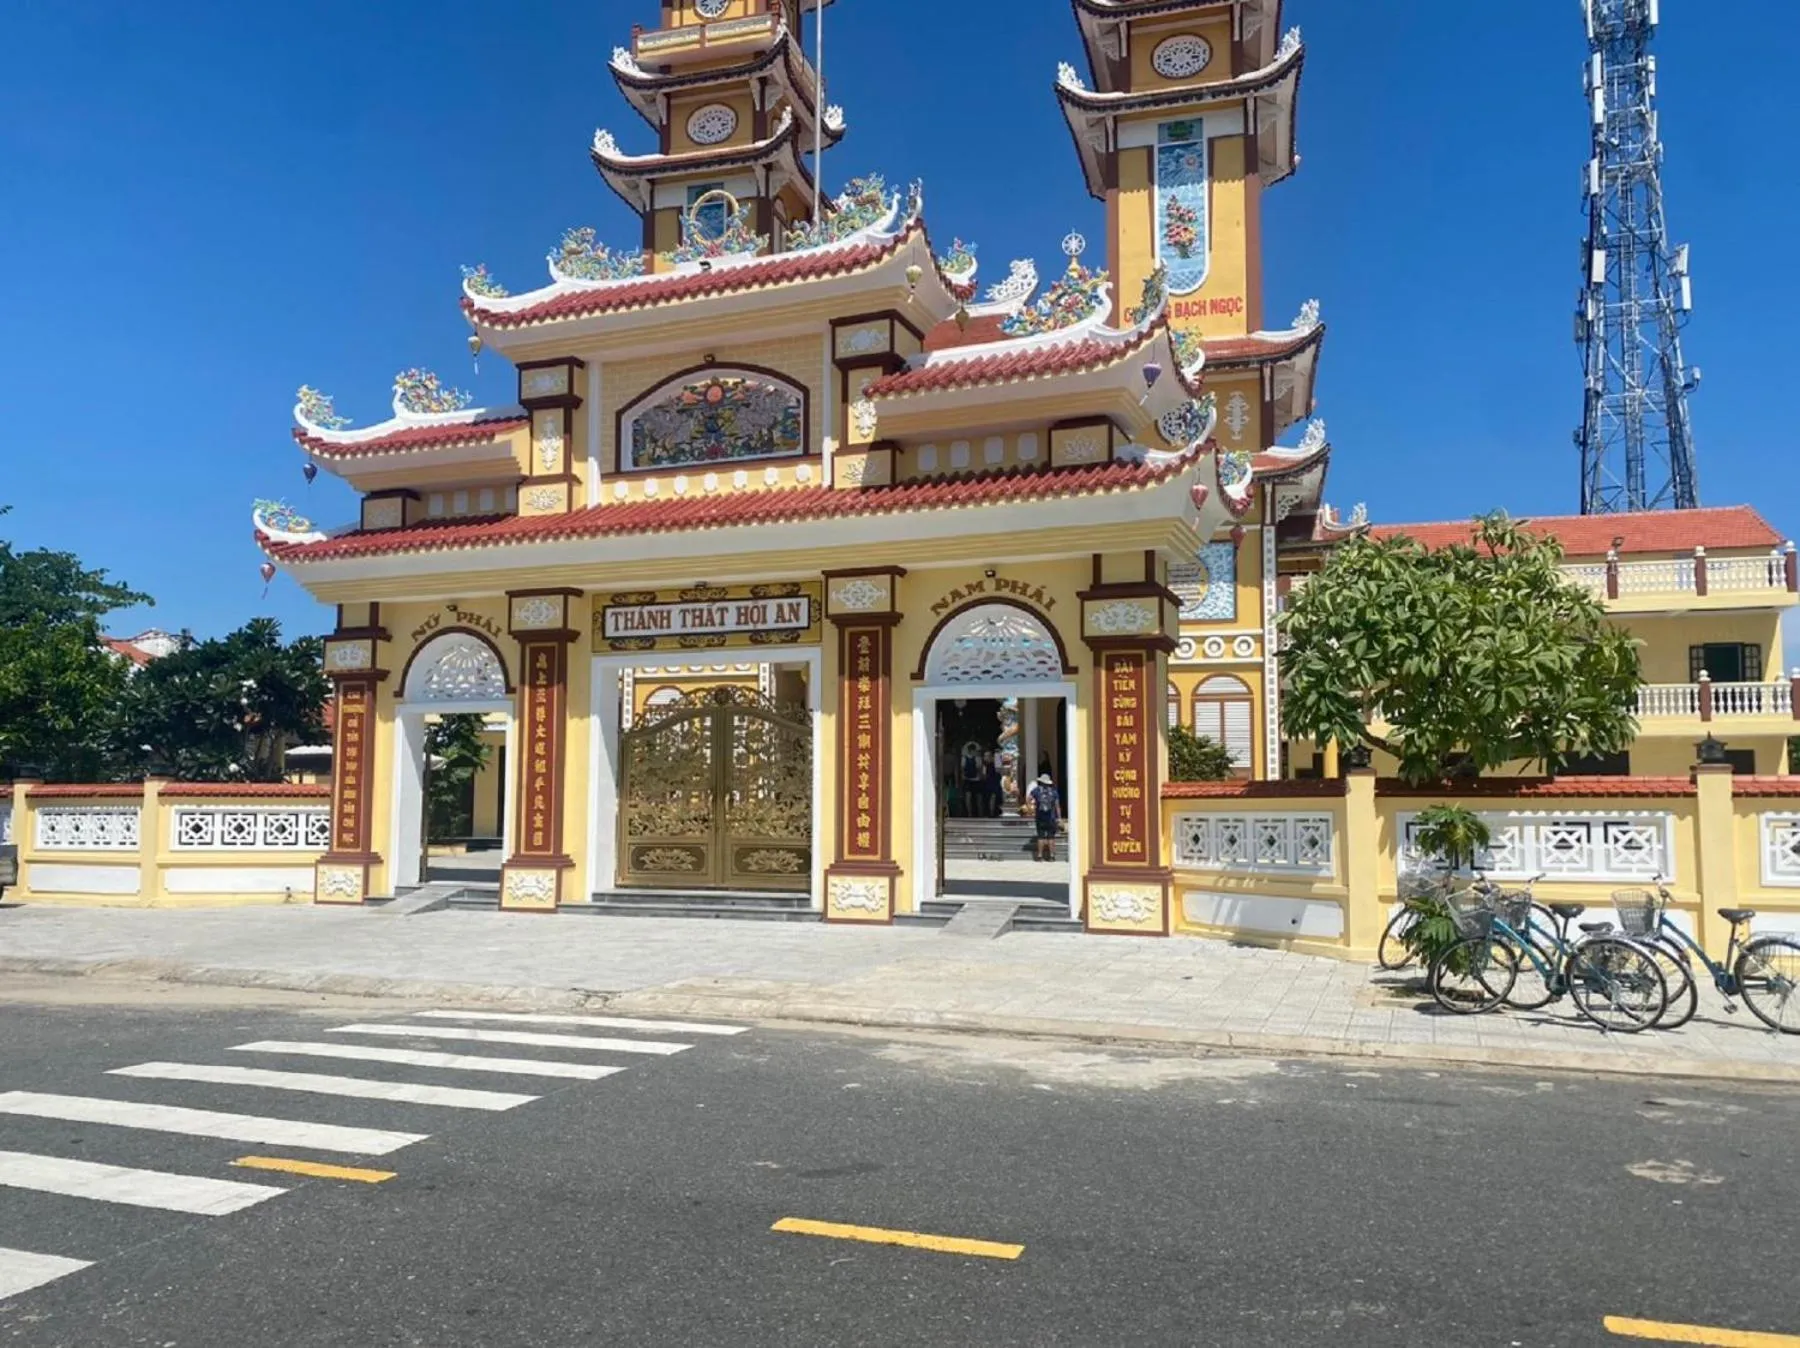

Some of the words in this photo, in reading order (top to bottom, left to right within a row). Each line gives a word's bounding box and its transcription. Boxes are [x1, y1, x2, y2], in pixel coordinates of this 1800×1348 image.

[1175, 300, 1207, 320] BẠCH
[1210, 297, 1243, 317] NGỌC
[930, 580, 986, 617] NAM
[994, 578, 1057, 612] PHÁI
[456, 611, 502, 638] PHÁI
[610, 606, 672, 632] THÁNH
[679, 602, 729, 628] THẤT
[735, 600, 768, 629] HỘI
[774, 602, 801, 624] AN
[1114, 732, 1137, 745] TAM
